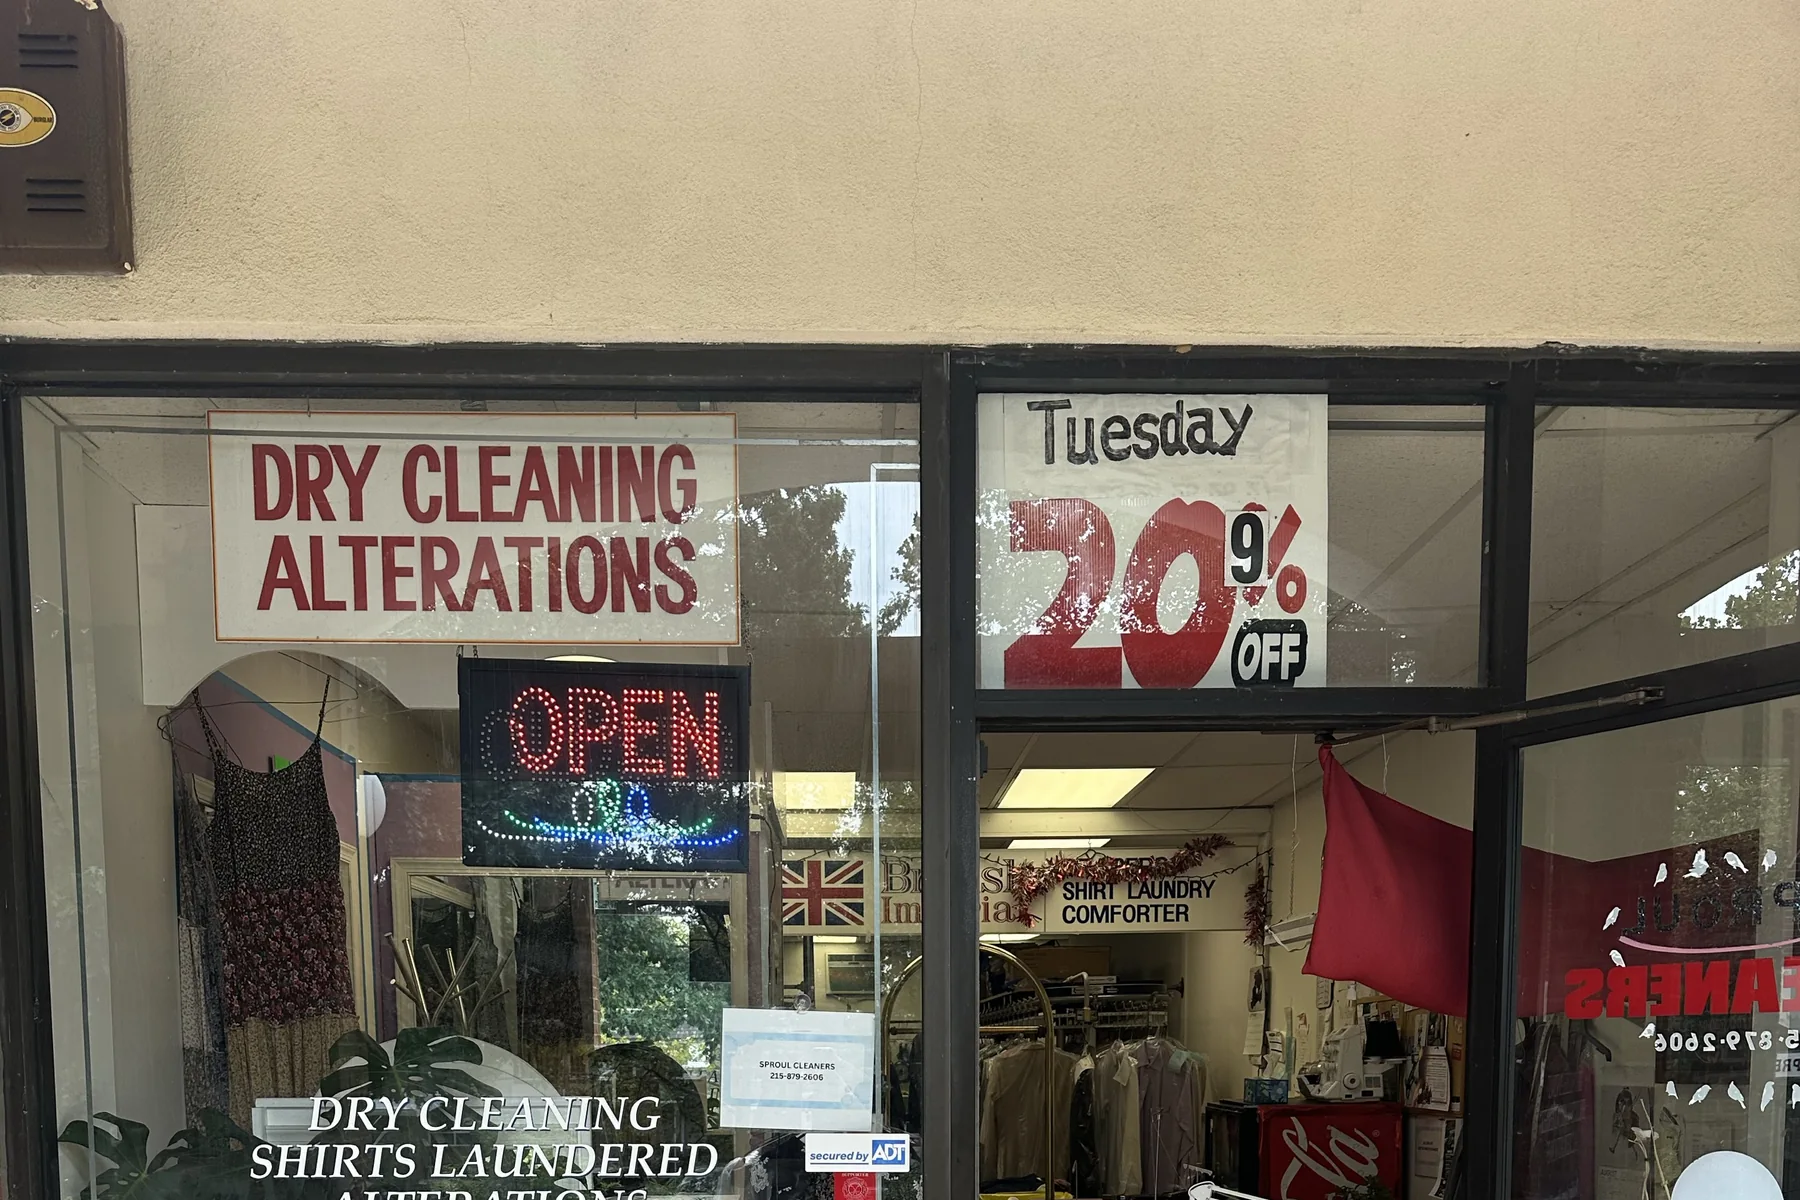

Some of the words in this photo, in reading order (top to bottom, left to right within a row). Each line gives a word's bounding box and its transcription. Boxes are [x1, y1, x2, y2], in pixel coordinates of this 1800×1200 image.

[1026, 399, 1253, 465] Tuesday
[251, 443, 381, 521] DRY
[401, 444, 697, 524] CLEANING
[257, 535, 699, 615] ALTERATIONS
[1238, 632, 1300, 681] OFF
[509, 687, 720, 778] OPEN
[1062, 881, 1115, 900] SHIRT
[1127, 880, 1216, 899] LAUNDRY
[1062, 904, 1189, 924] COMFORTER
[759, 1061, 791, 1069] SPROUL
[793, 1062, 836, 1070] CLEANERS
[770, 1072, 824, 1081] 215-879-2606
[308, 1096, 409, 1133] DRY
[419, 1095, 662, 1133] CLEANING
[249, 1144, 416, 1180] SHIRTS
[431, 1142, 719, 1178] LAUNDERED
[810, 1152, 854, 1160] secured
[856, 1152, 869, 1162] by
[872, 1143, 905, 1161] ADT
